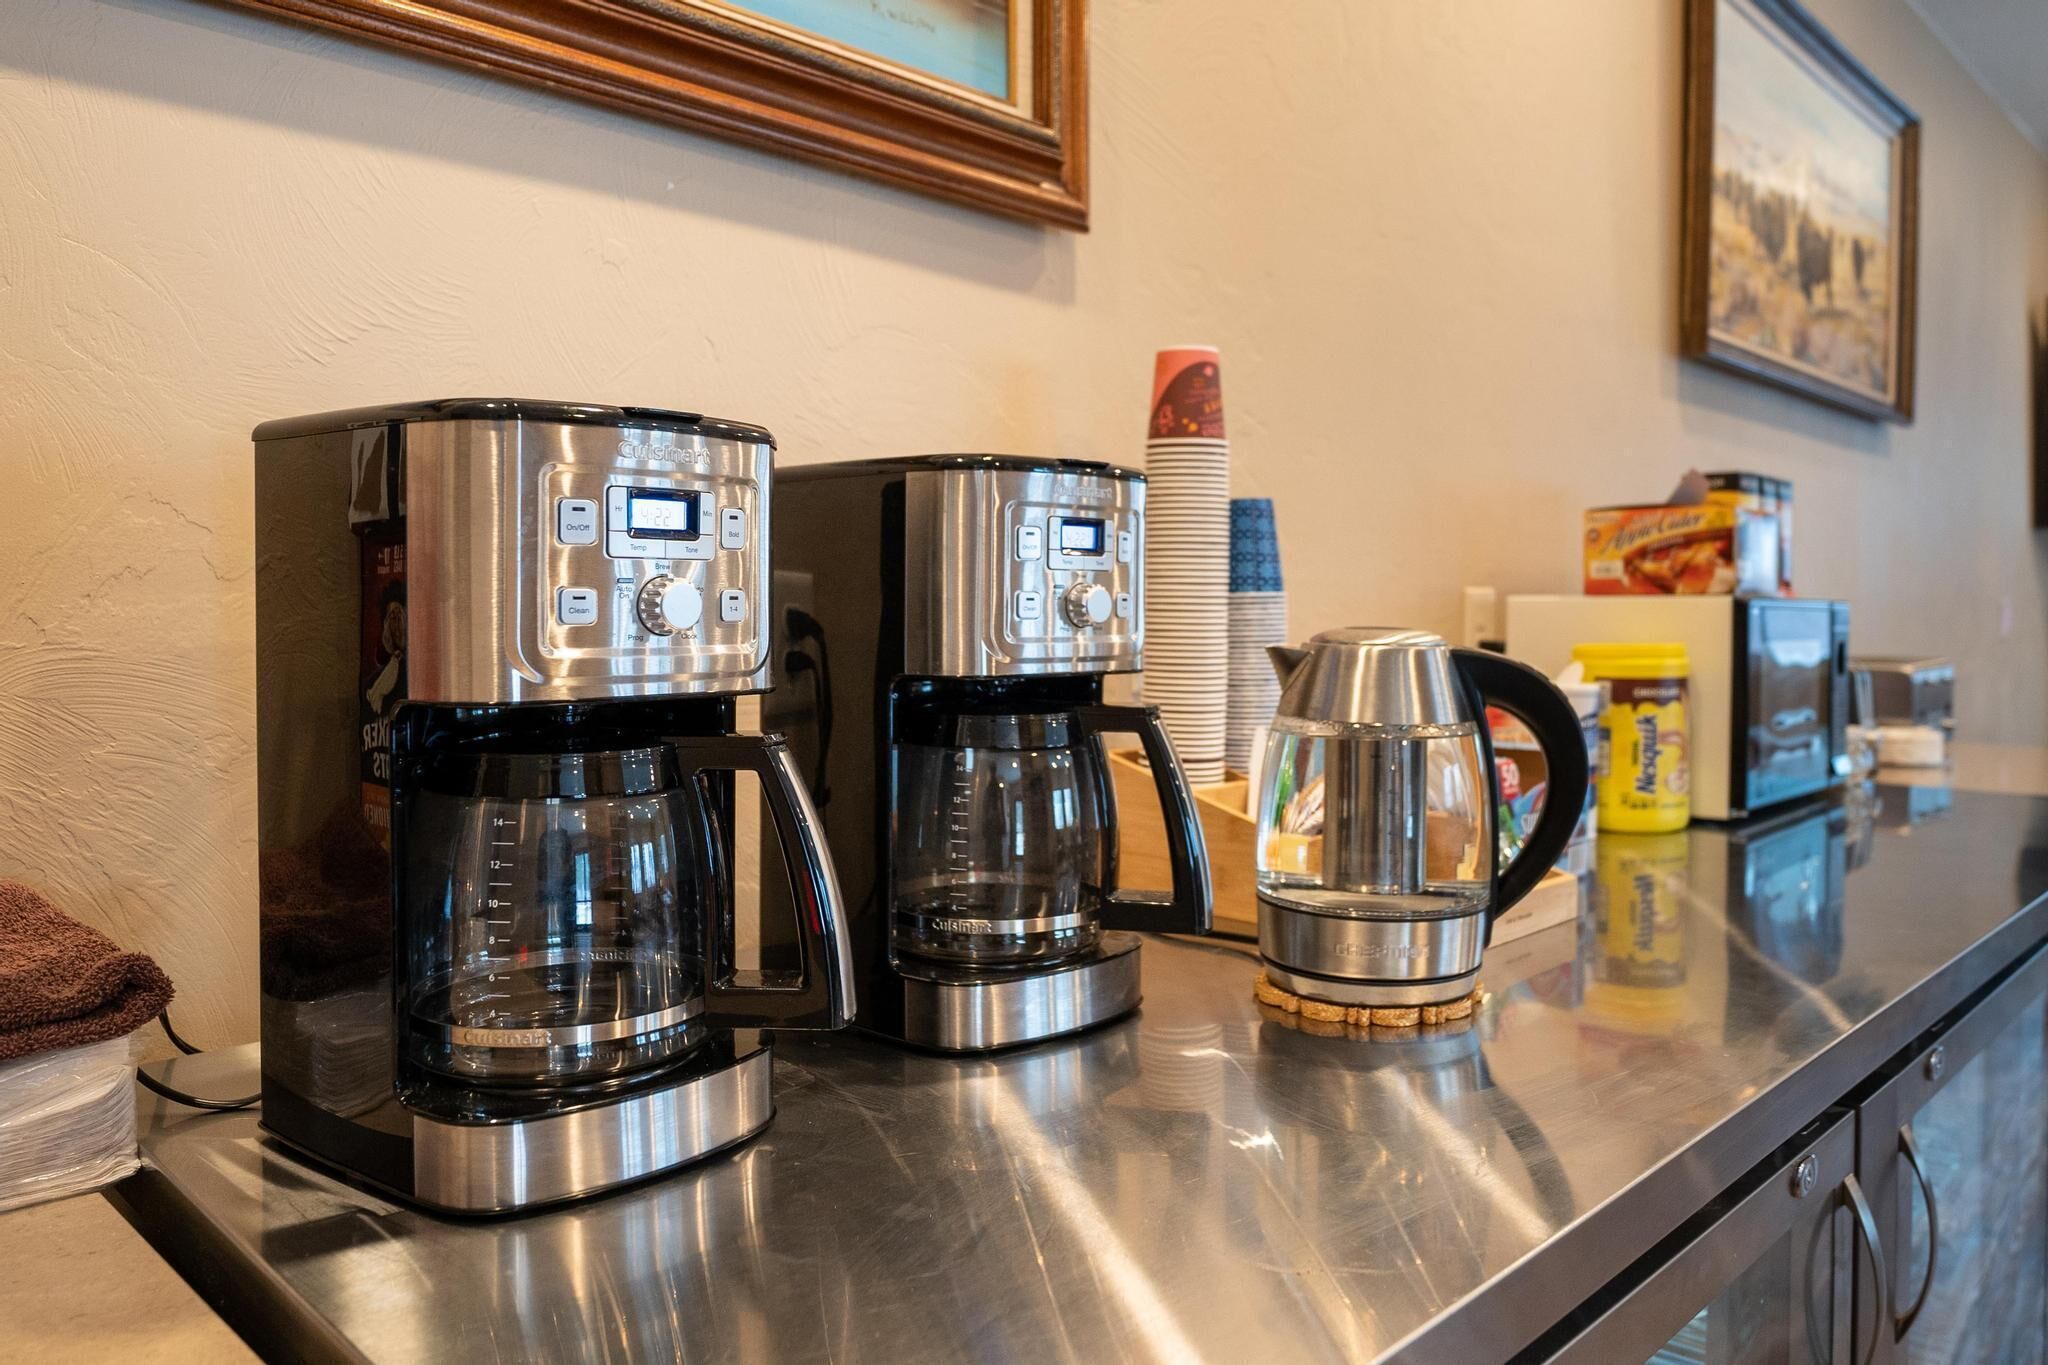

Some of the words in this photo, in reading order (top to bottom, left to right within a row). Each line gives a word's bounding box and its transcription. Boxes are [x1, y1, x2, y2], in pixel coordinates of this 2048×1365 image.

[617, 439, 712, 466] Cuisinart
[702, 510, 713, 518] Min
[566, 523, 590, 532] On/Off
[630, 544, 647, 553] Temp
[655, 562, 671, 570] Brew
[568, 607, 590, 615] Clean
[493, 818, 504, 827] 14
[951, 824, 959, 832] 10
[489, 860, 501, 869] 12
[487, 899, 498, 908] 10
[932, 917, 993, 935] Cuisinart
[488, 936, 495, 945] 8
[488, 974, 495, 982] 6
[489, 1009, 496, 1018] 4
[463, 1029, 552, 1045] Cuisinart
